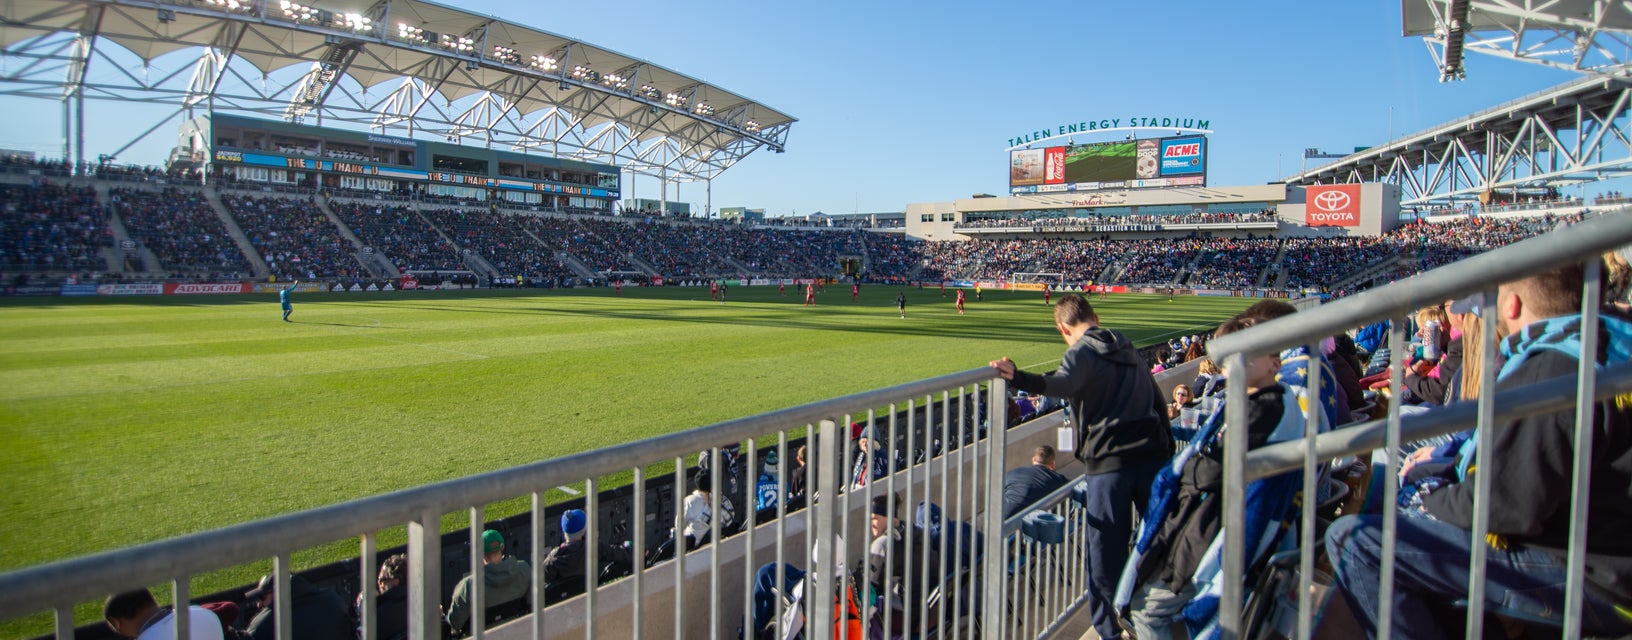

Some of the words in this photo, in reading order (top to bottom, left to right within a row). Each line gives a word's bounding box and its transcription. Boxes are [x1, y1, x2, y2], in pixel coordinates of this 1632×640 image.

[1008, 129, 1051, 148] TALEN
[1059, 118, 1121, 135] ENERGY
[1130, 117, 1210, 130] STADIUM
[1164, 143, 1200, 158] ACME
[287, 157, 306, 169] THE
[315, 159, 323, 170] U
[333, 162, 364, 174] THANK
[371, 165, 379, 175] U
[1054, 151, 1064, 180] Coca-Cola
[428, 172, 443, 181] THE
[450, 174, 456, 183] U
[463, 176, 488, 186] THANK
[493, 178, 499, 187] U
[533, 183, 545, 191] THE
[561, 186, 581, 195] THANK
[1310, 212, 1354, 221] TOYOTA
[174, 283, 242, 294] ADVOCARE
